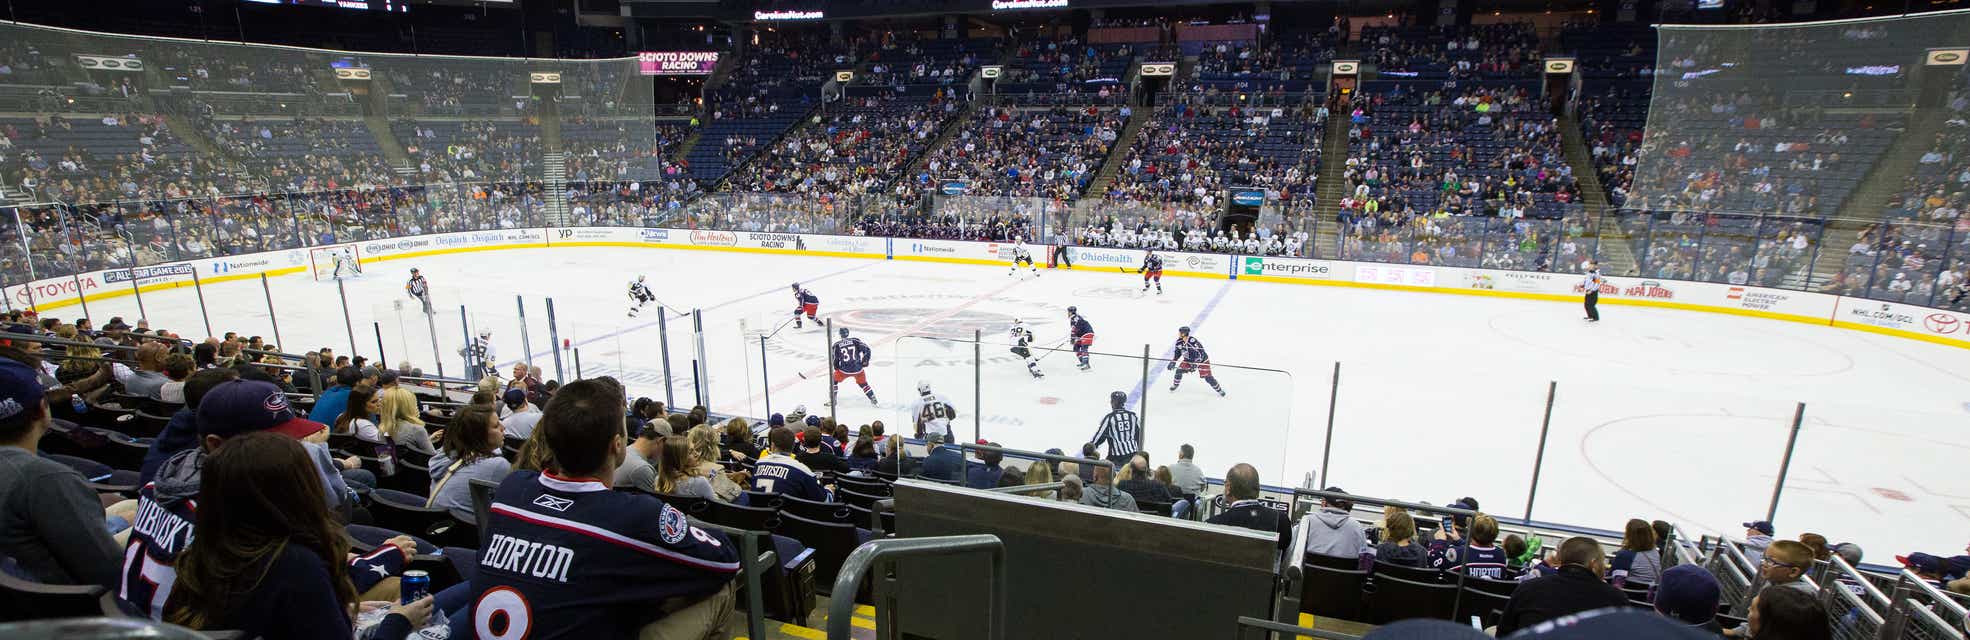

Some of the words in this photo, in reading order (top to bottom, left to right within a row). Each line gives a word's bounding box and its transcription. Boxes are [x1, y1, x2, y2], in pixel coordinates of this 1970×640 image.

[754, 10, 824, 20] CarolinaNut.com
[639, 52, 678, 61] SCIOTO
[680, 52, 719, 62] DOWNS
[662, 61, 698, 70] RACINO
[558, 229, 573, 239] yp
[693, 230, 706, 241] Tim
[750, 233, 770, 242] SCIOTO
[771, 234, 796, 242] DOWNS
[761, 241, 785, 249] RACINO
[1081, 252, 1133, 264] OhioHealth
[229, 259, 269, 270] Nationwide
[1247, 258, 1329, 274] enterprise
[150, 267, 174, 277] GAME
[36, 276, 97, 299] TOYOTA
[840, 346, 857, 362] 37
[922, 401, 945, 421] 46
[1118, 421, 1131, 432] 83
[753, 465, 790, 480] JOHNSON
[689, 526, 722, 548] 8
[481, 534, 575, 583] HORTON
[1469, 567, 1502, 579] HORTON
[119, 539, 178, 622] 17
